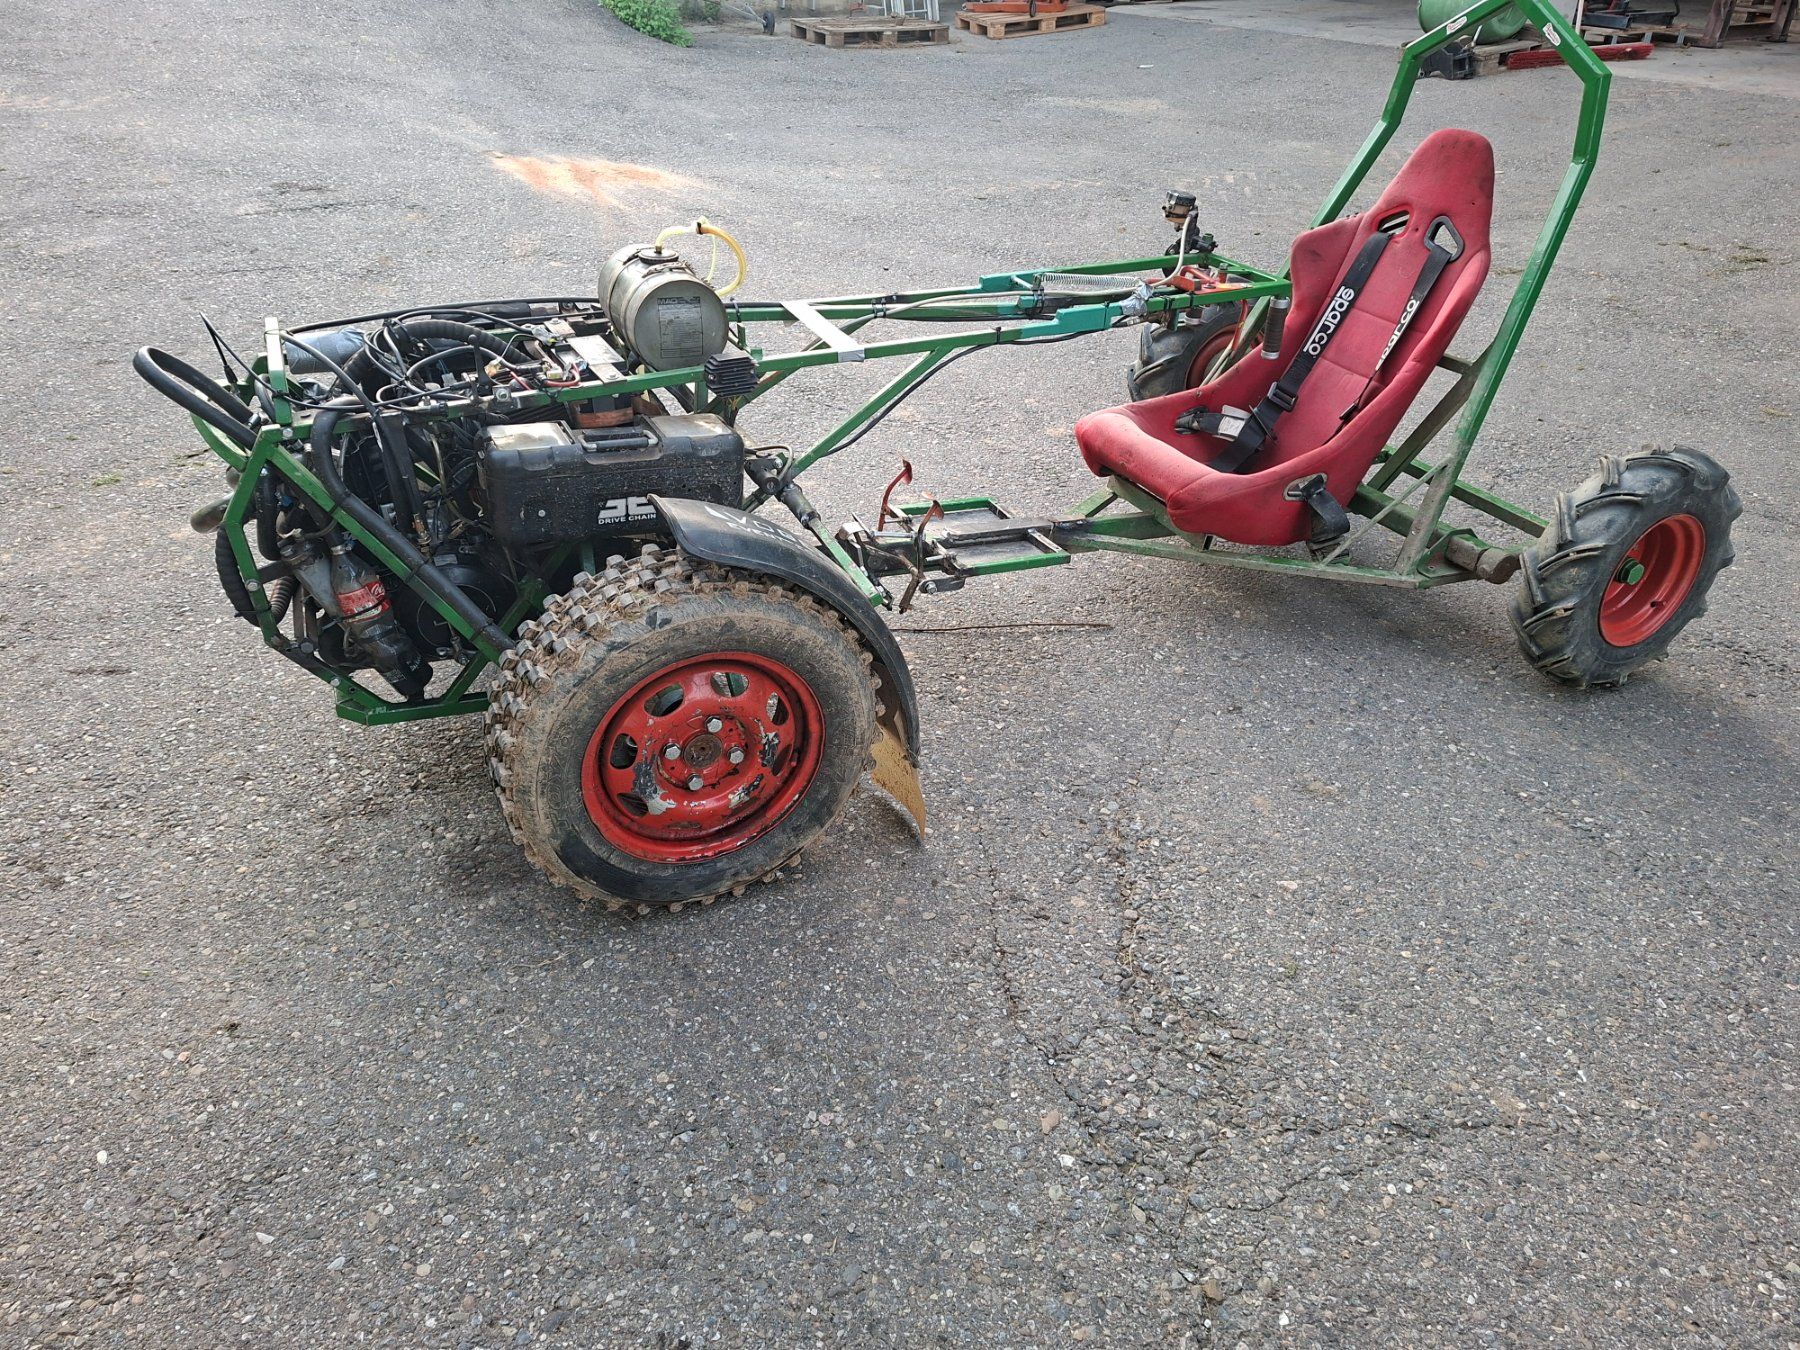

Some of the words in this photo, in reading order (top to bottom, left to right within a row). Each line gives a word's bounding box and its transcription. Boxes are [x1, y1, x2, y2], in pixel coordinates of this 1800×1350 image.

[1303, 285, 1355, 356] sparco
[598, 516, 627, 525] DRIVE
[628, 513, 657, 521] CHAIN
